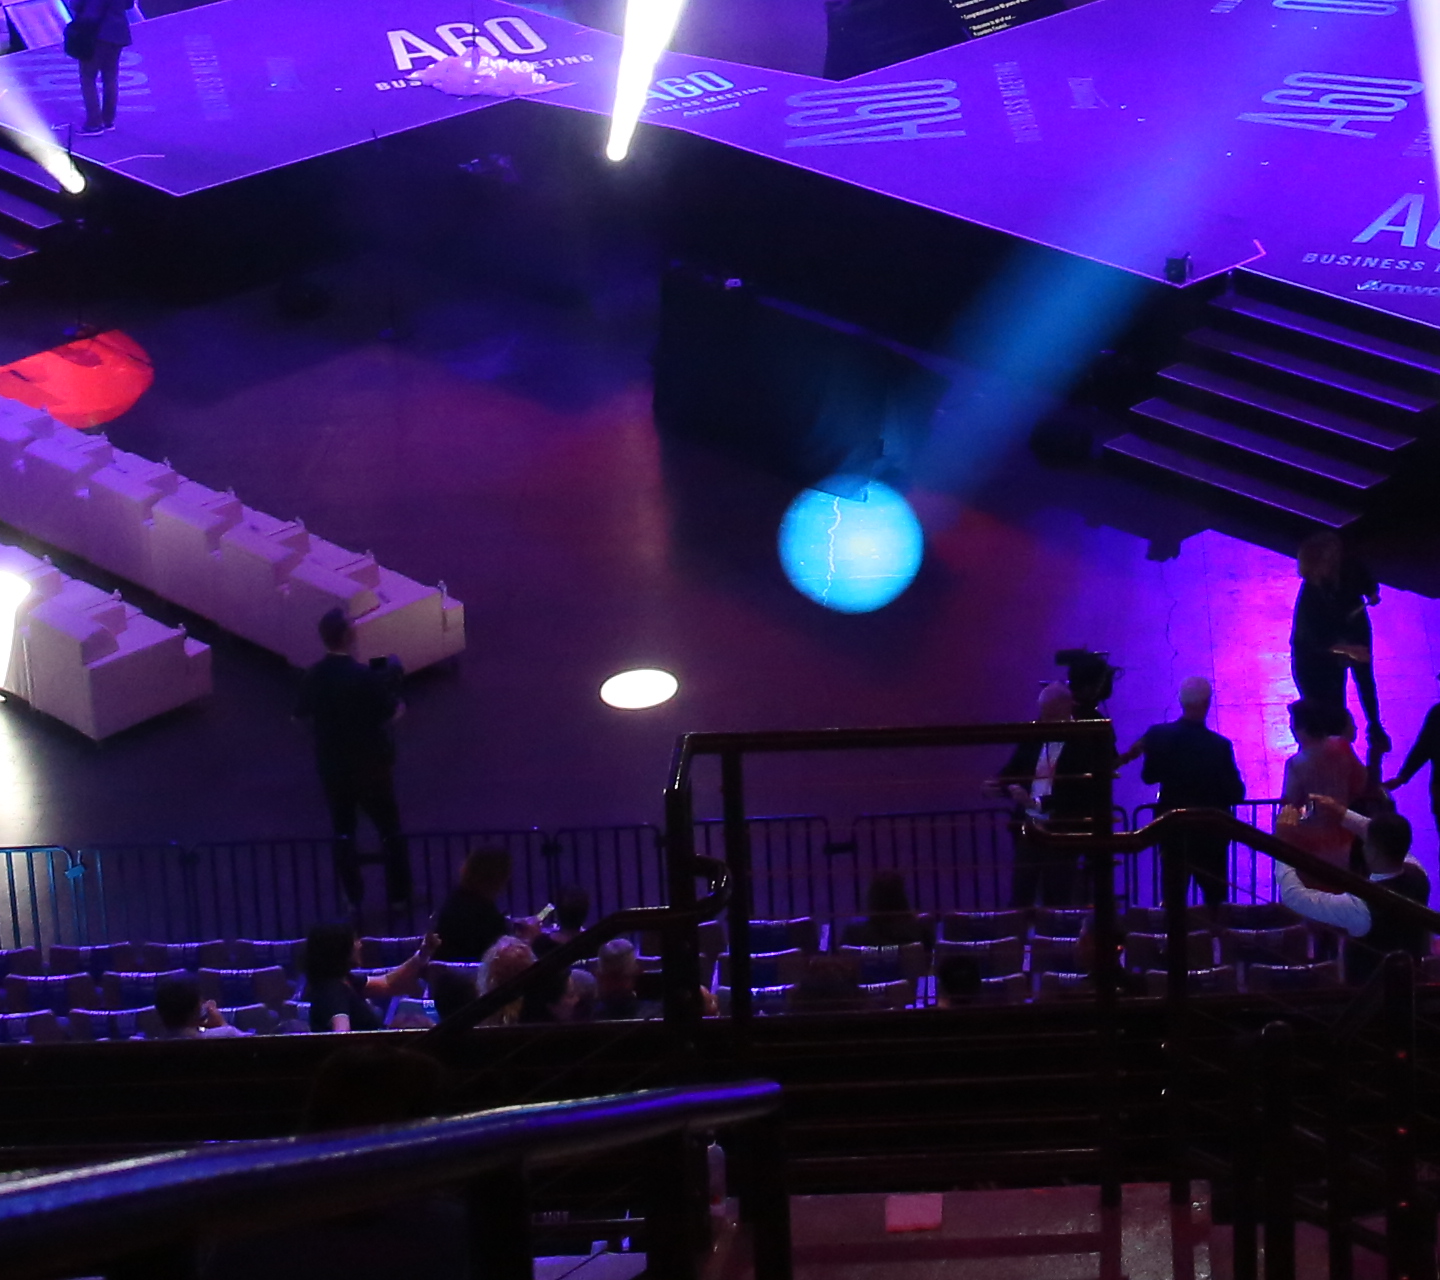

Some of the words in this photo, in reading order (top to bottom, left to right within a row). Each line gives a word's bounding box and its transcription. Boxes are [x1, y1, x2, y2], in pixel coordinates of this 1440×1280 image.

[784, 78, 967, 148] A60
[1237, 71, 1425, 139] A60
[1302, 252, 1426, 272] BUSINESS
